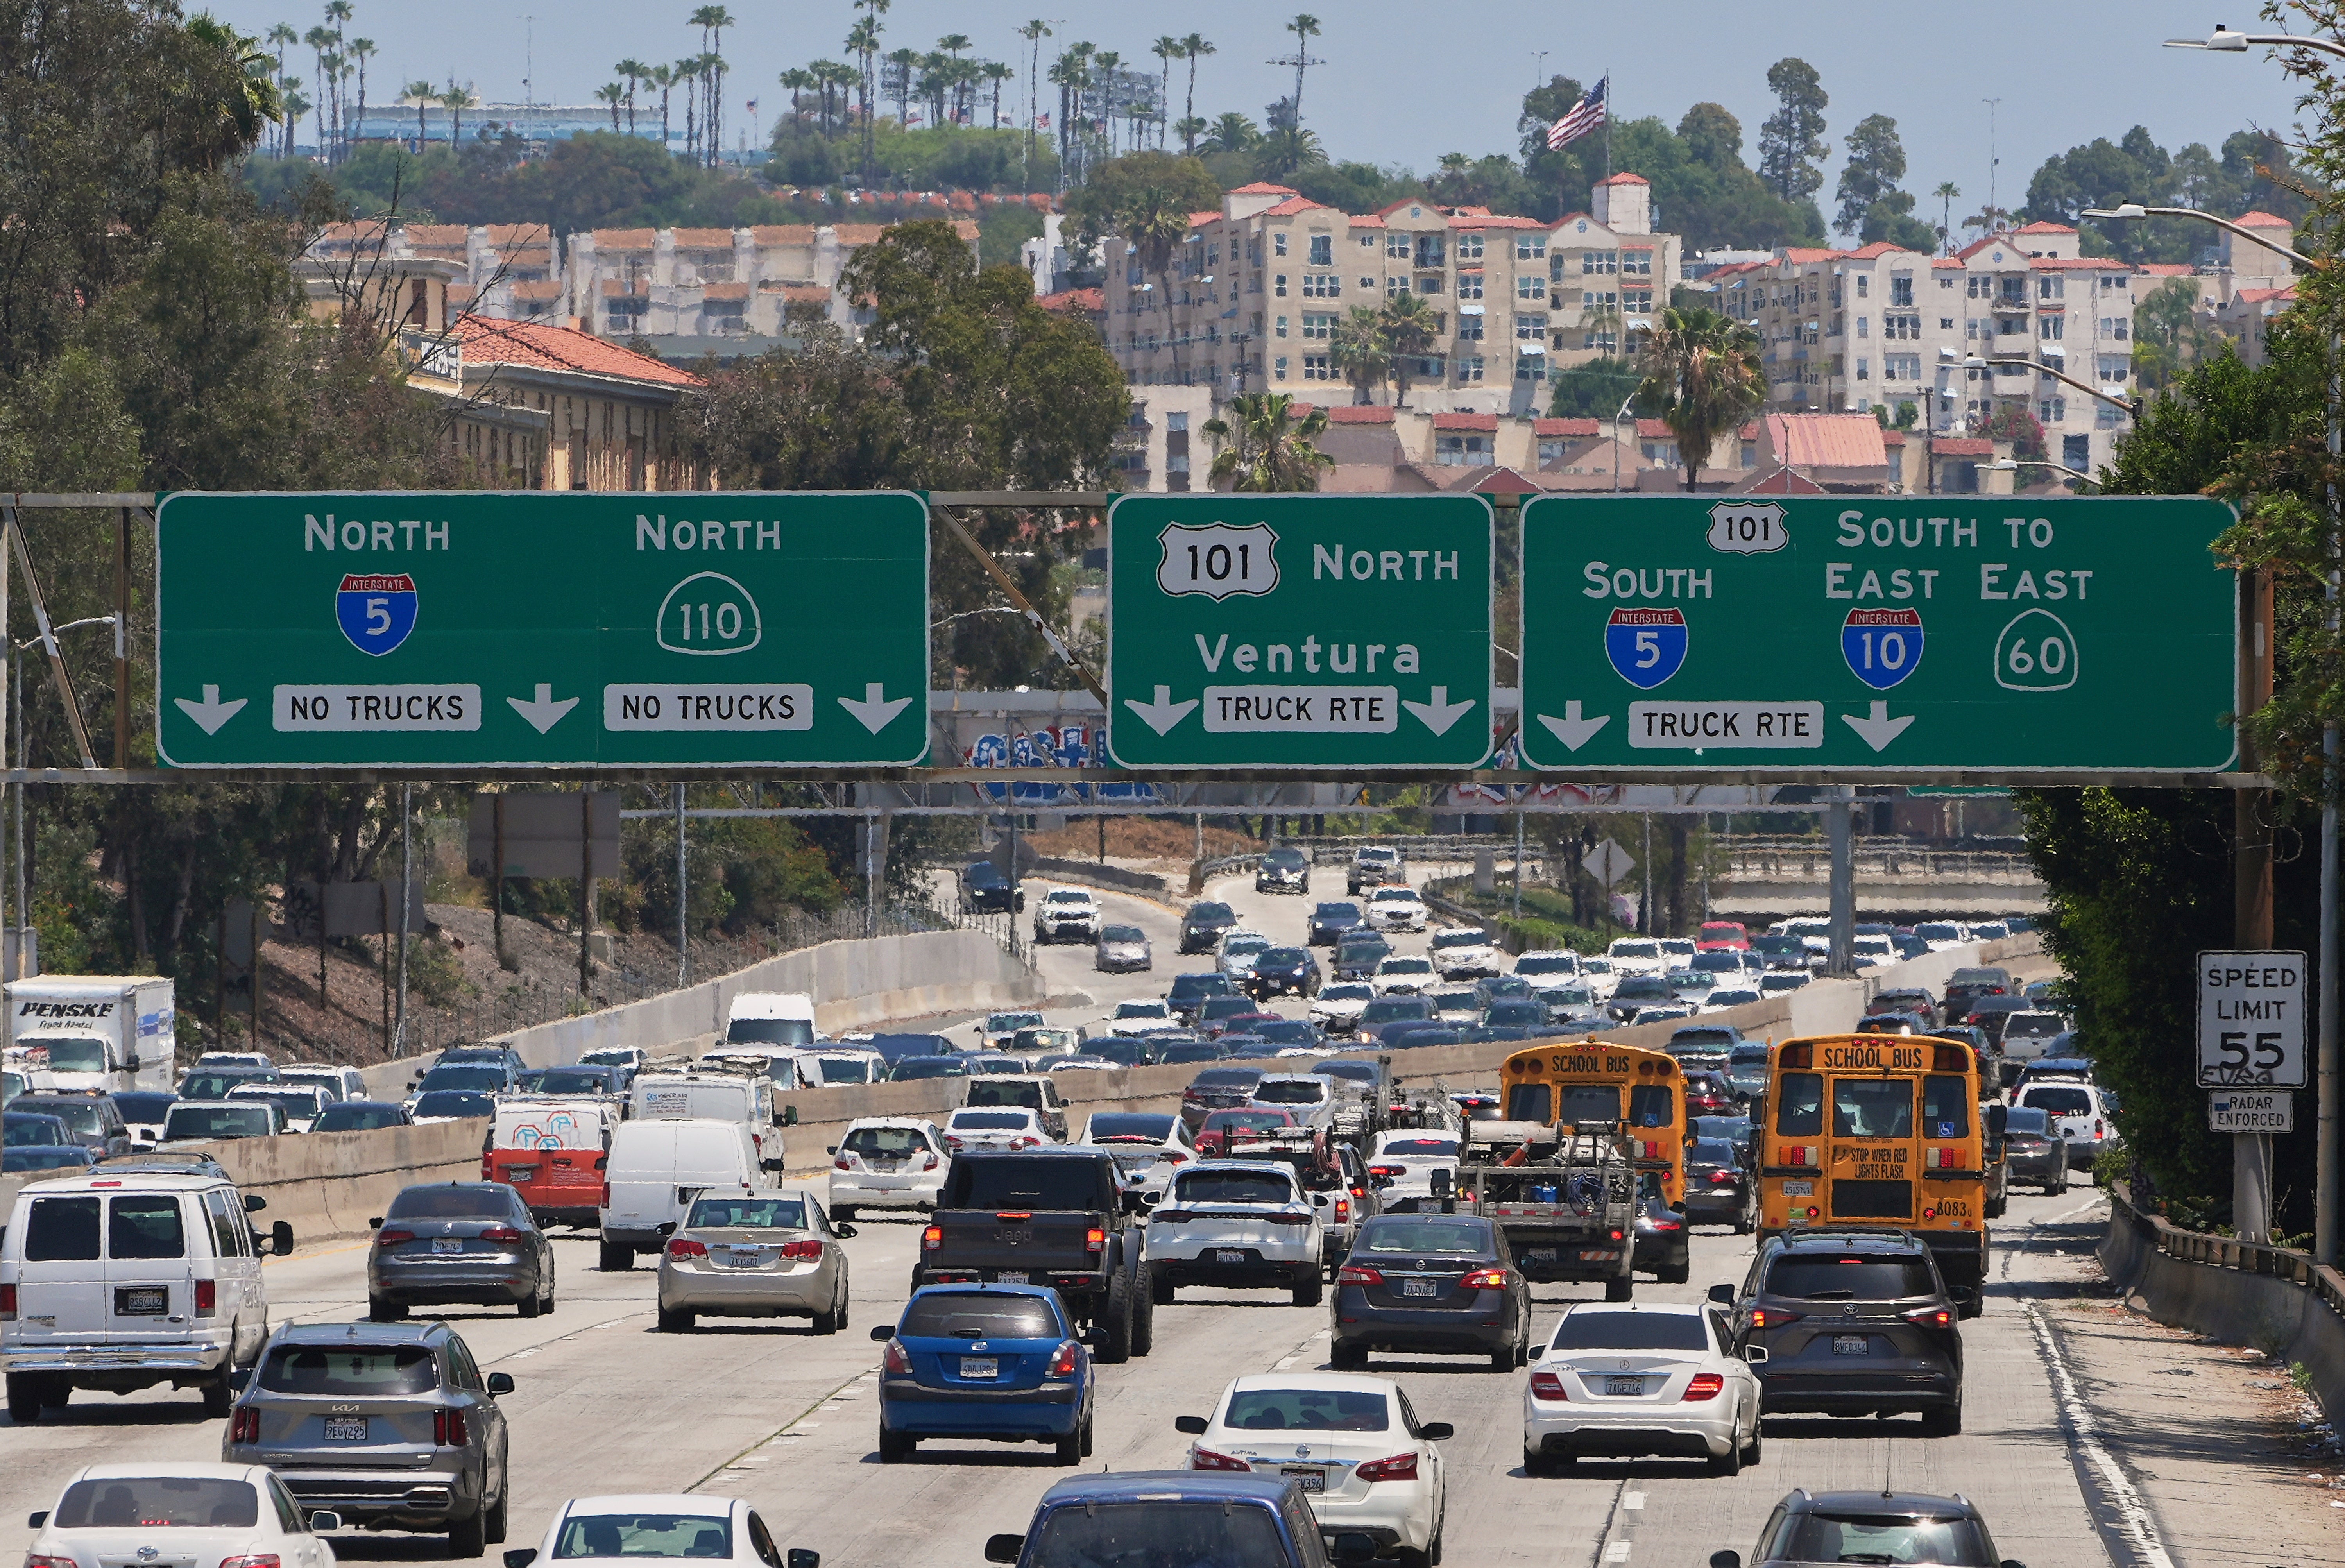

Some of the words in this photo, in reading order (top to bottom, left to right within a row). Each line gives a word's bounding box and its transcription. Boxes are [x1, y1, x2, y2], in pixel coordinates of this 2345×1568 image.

[304, 514, 449, 551] NORTH
[636, 514, 780, 551] NORTH
[1726, 517, 1768, 541] 101
[1836, 510, 1978, 548] SOUTH
[2003, 518, 2054, 548] TO
[1187, 544, 1248, 580] 101
[1313, 544, 1458, 580] NORTH
[349, 579, 405, 590] INTERSTATE
[1582, 561, 1712, 599] SOUTH
[1826, 562, 1939, 599] EAST
[1980, 563, 2093, 600] EAST
[365, 598, 391, 635] 5
[680, 602, 742, 640] 110
[1618, 613, 1674, 623] INTERSTATE
[1855, 613, 1910, 624] INTERSTATE
[1194, 634, 1419, 673] Ventura
[1635, 632, 1660, 668] 5
[1862, 632, 1906, 670] 10
[2009, 636, 2066, 675] 60
[291, 696, 329, 720] NO
[346, 696, 463, 720] TRUCKS
[623, 695, 661, 720] NO
[677, 695, 794, 720] TRUCKS
[1217, 696, 1312, 721] TRUCK
[1330, 697, 1384, 721] RTE
[1642, 712, 1740, 737] TRUCK
[1757, 712, 1809, 737] RTE
[2208, 968, 2297, 988] SPEED
[19, 1002, 113, 1017] PENSKE
[2218, 999, 2286, 1020] LIMIT
[1552, 1055, 1600, 1072] SCHOOL
[1607, 1056, 1629, 1072] BUS
[1824, 1048, 1884, 1068] SCHOOL
[1891, 1048, 1922, 1068] BUS
[2220, 1032, 2284, 1070] 55
[2230, 1097, 2273, 1110] RADAR
[2218, 1112, 2284, 1126] ENFORCED
[1851, 1147, 1869, 1162] STOP
[1872, 1148, 1891, 1162] WHEN
[1894, 1148, 1907, 1163] RED
[1855, 1163, 1880, 1178] LIGHTS
[1881, 1163, 1903, 1179] FLASH
[1937, 1201, 1966, 1217] 8083
[994, 1229, 1032, 1244] Jeep
